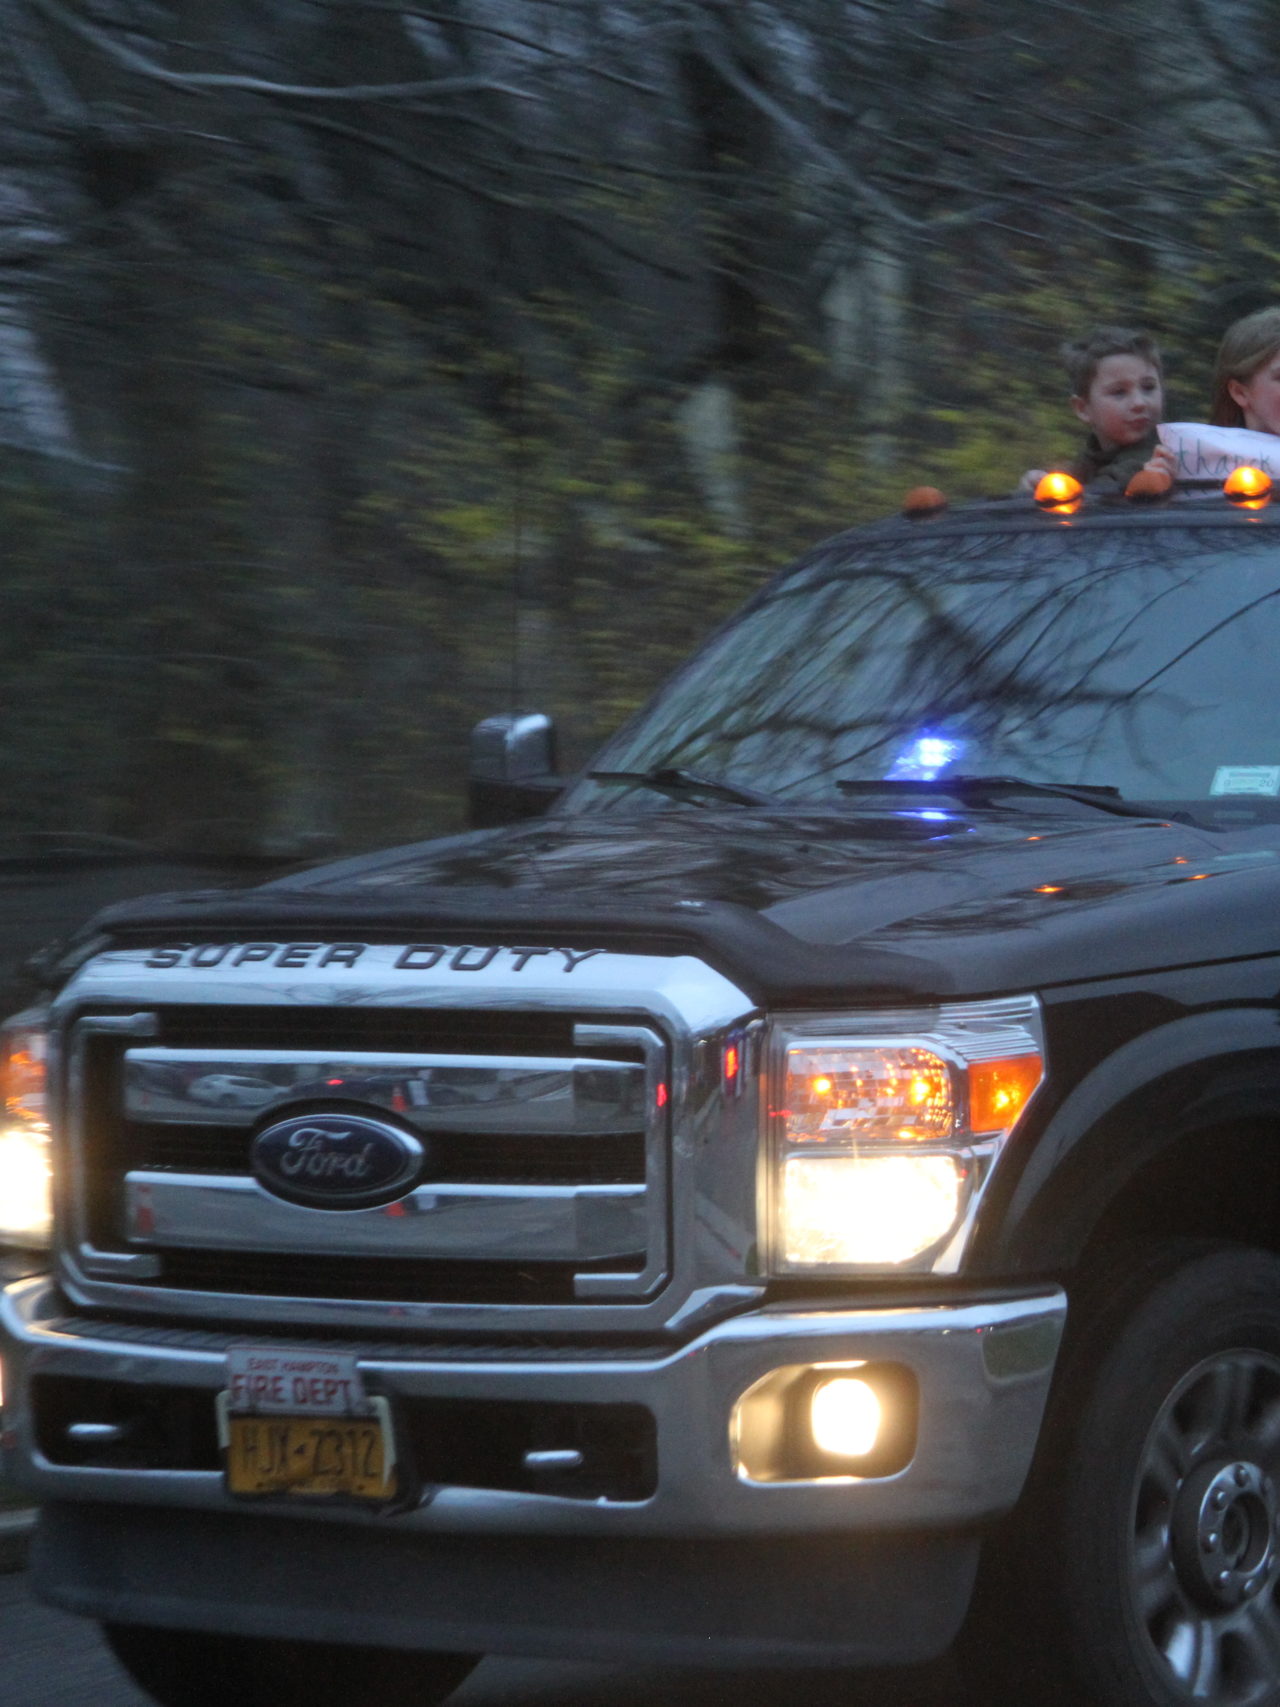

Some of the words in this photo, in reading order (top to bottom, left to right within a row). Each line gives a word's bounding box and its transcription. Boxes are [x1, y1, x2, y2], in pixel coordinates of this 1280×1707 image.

[145, 942, 369, 969] SUPER
[394, 943, 605, 973] DUTY
[280, 1127, 375, 1176] Ford
[231, 1373, 285, 1404] FIRE
[292, 1376, 351, 1406] DEPT
